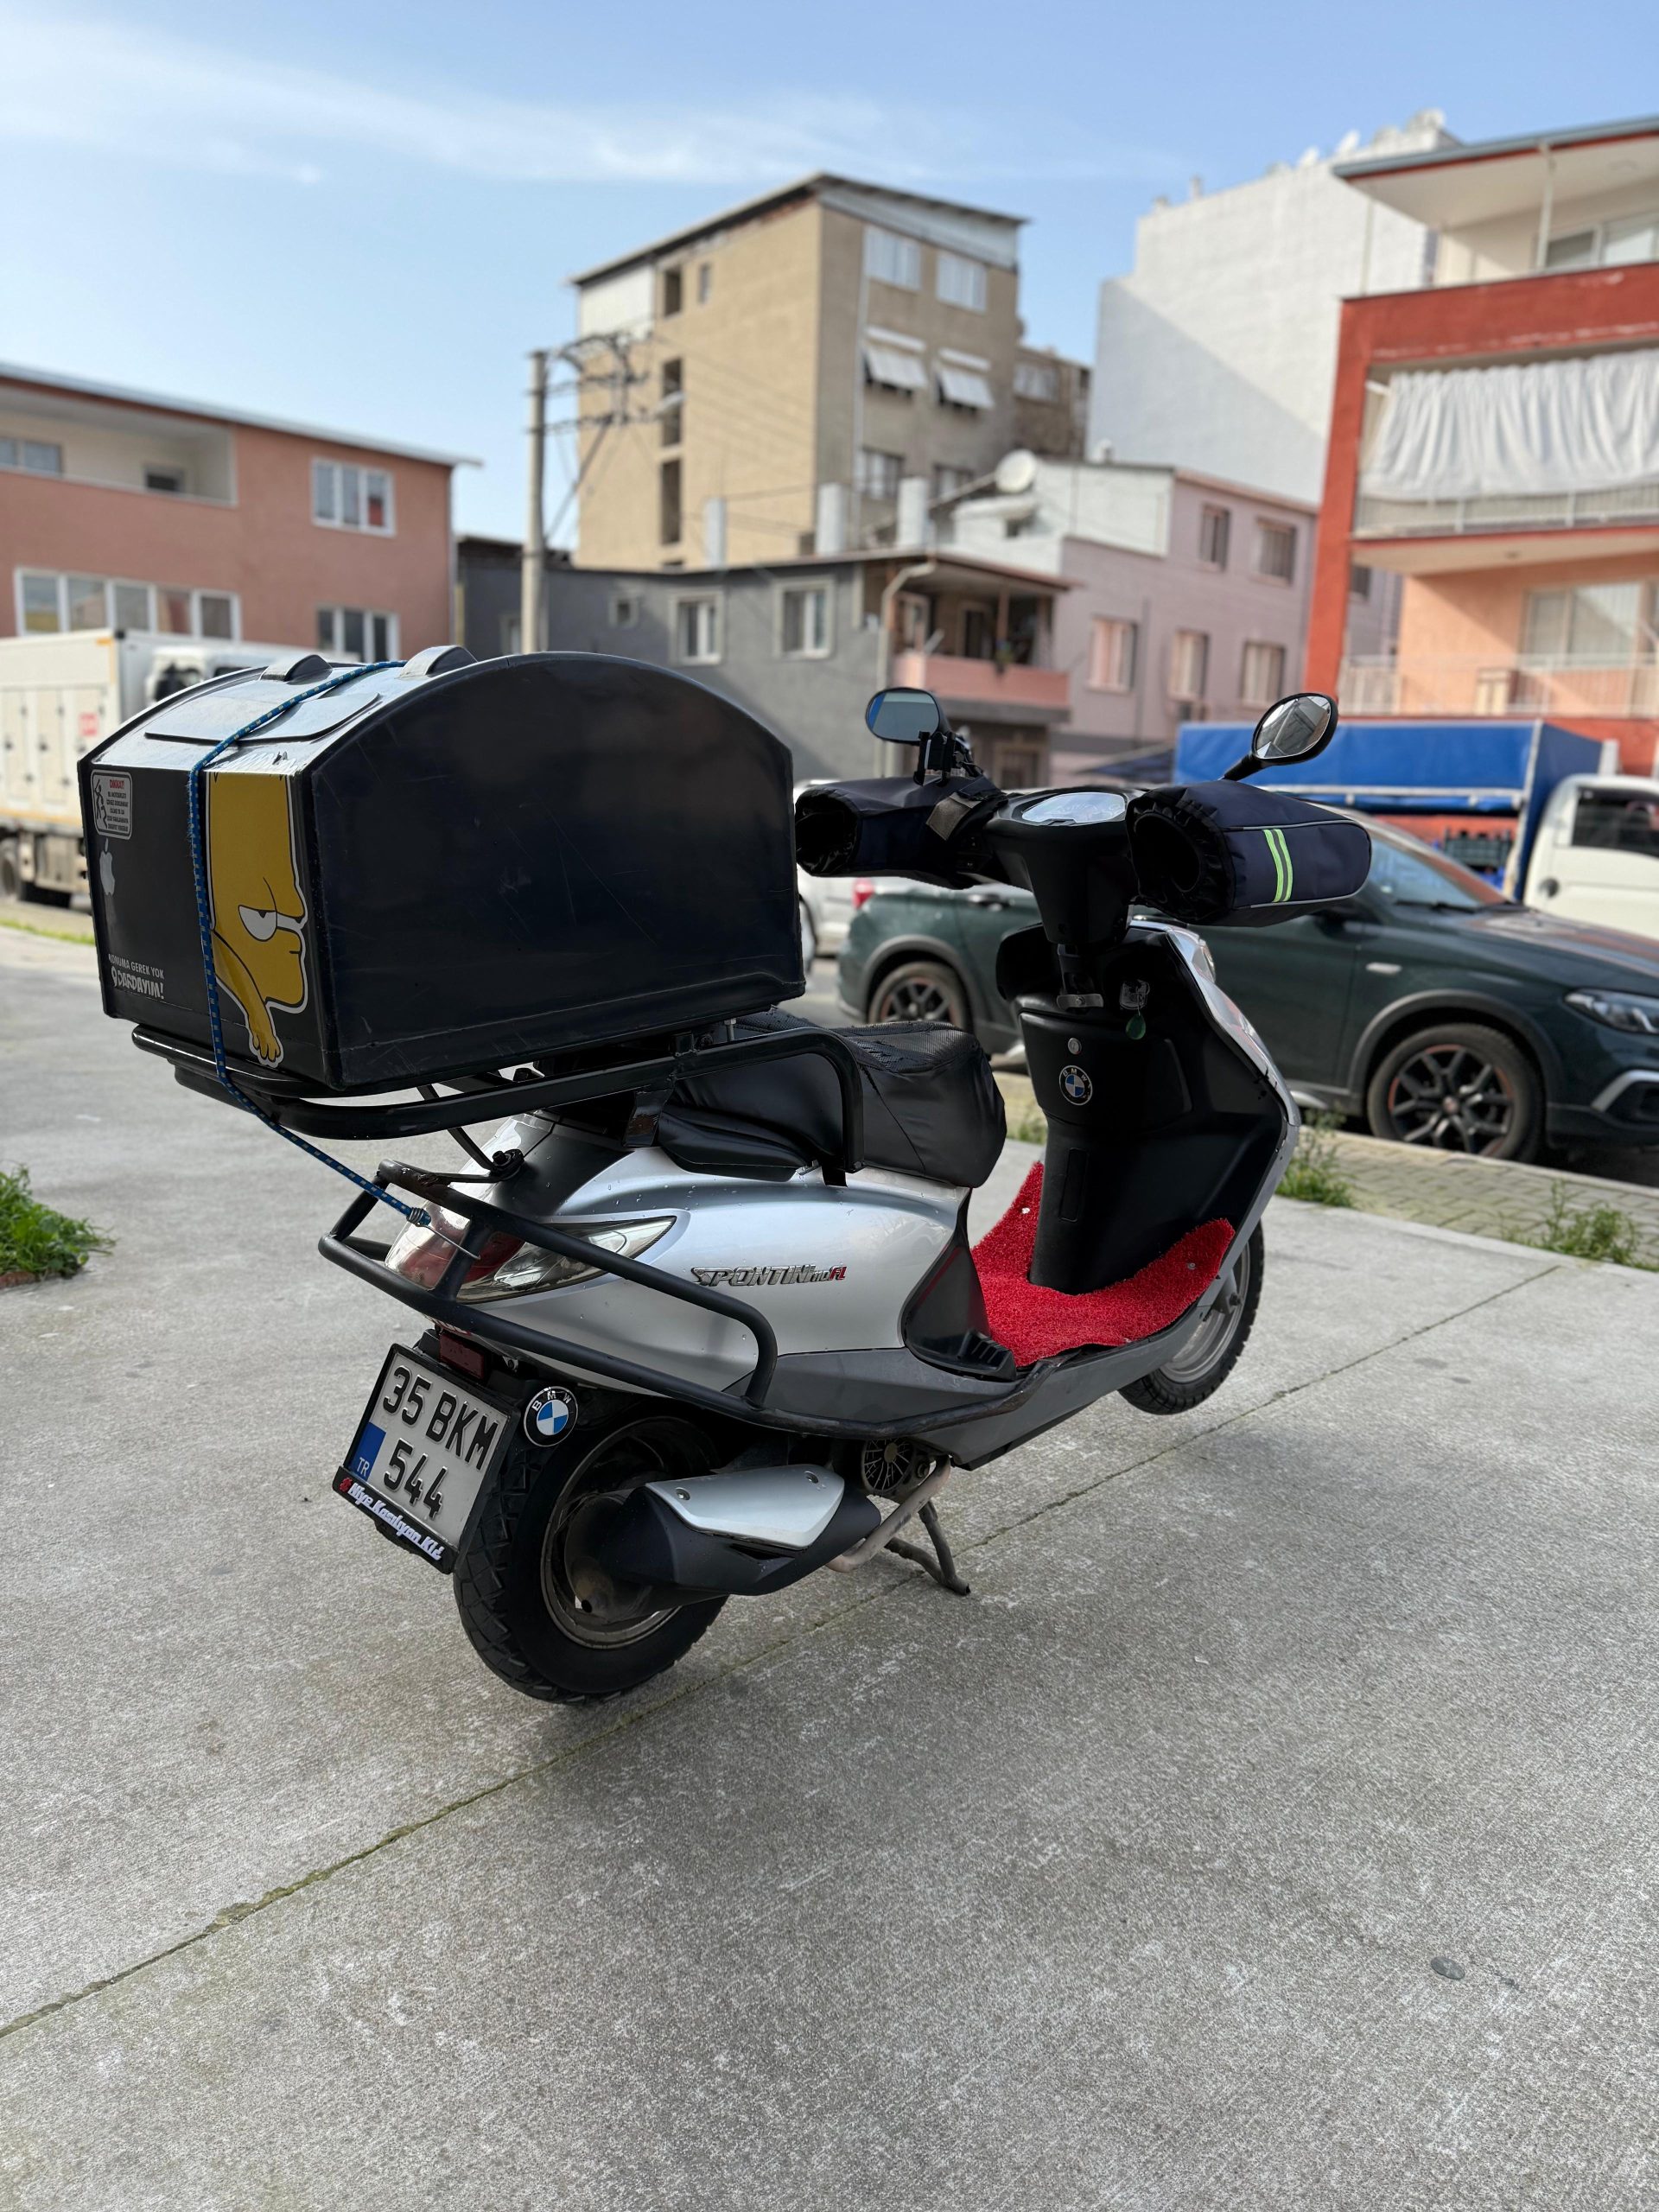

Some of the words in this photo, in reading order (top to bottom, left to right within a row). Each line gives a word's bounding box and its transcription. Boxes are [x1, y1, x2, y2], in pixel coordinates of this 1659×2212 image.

[130, 961, 150, 976] GEREK
[150, 966, 165, 980] YOK
[531, 1390, 572, 1412] BMW
[382, 1364, 433, 1426] 35
[425, 1390, 499, 1471] BKM
[356, 1457, 370, 1477] TR
[384, 1438, 448, 1521] 544
